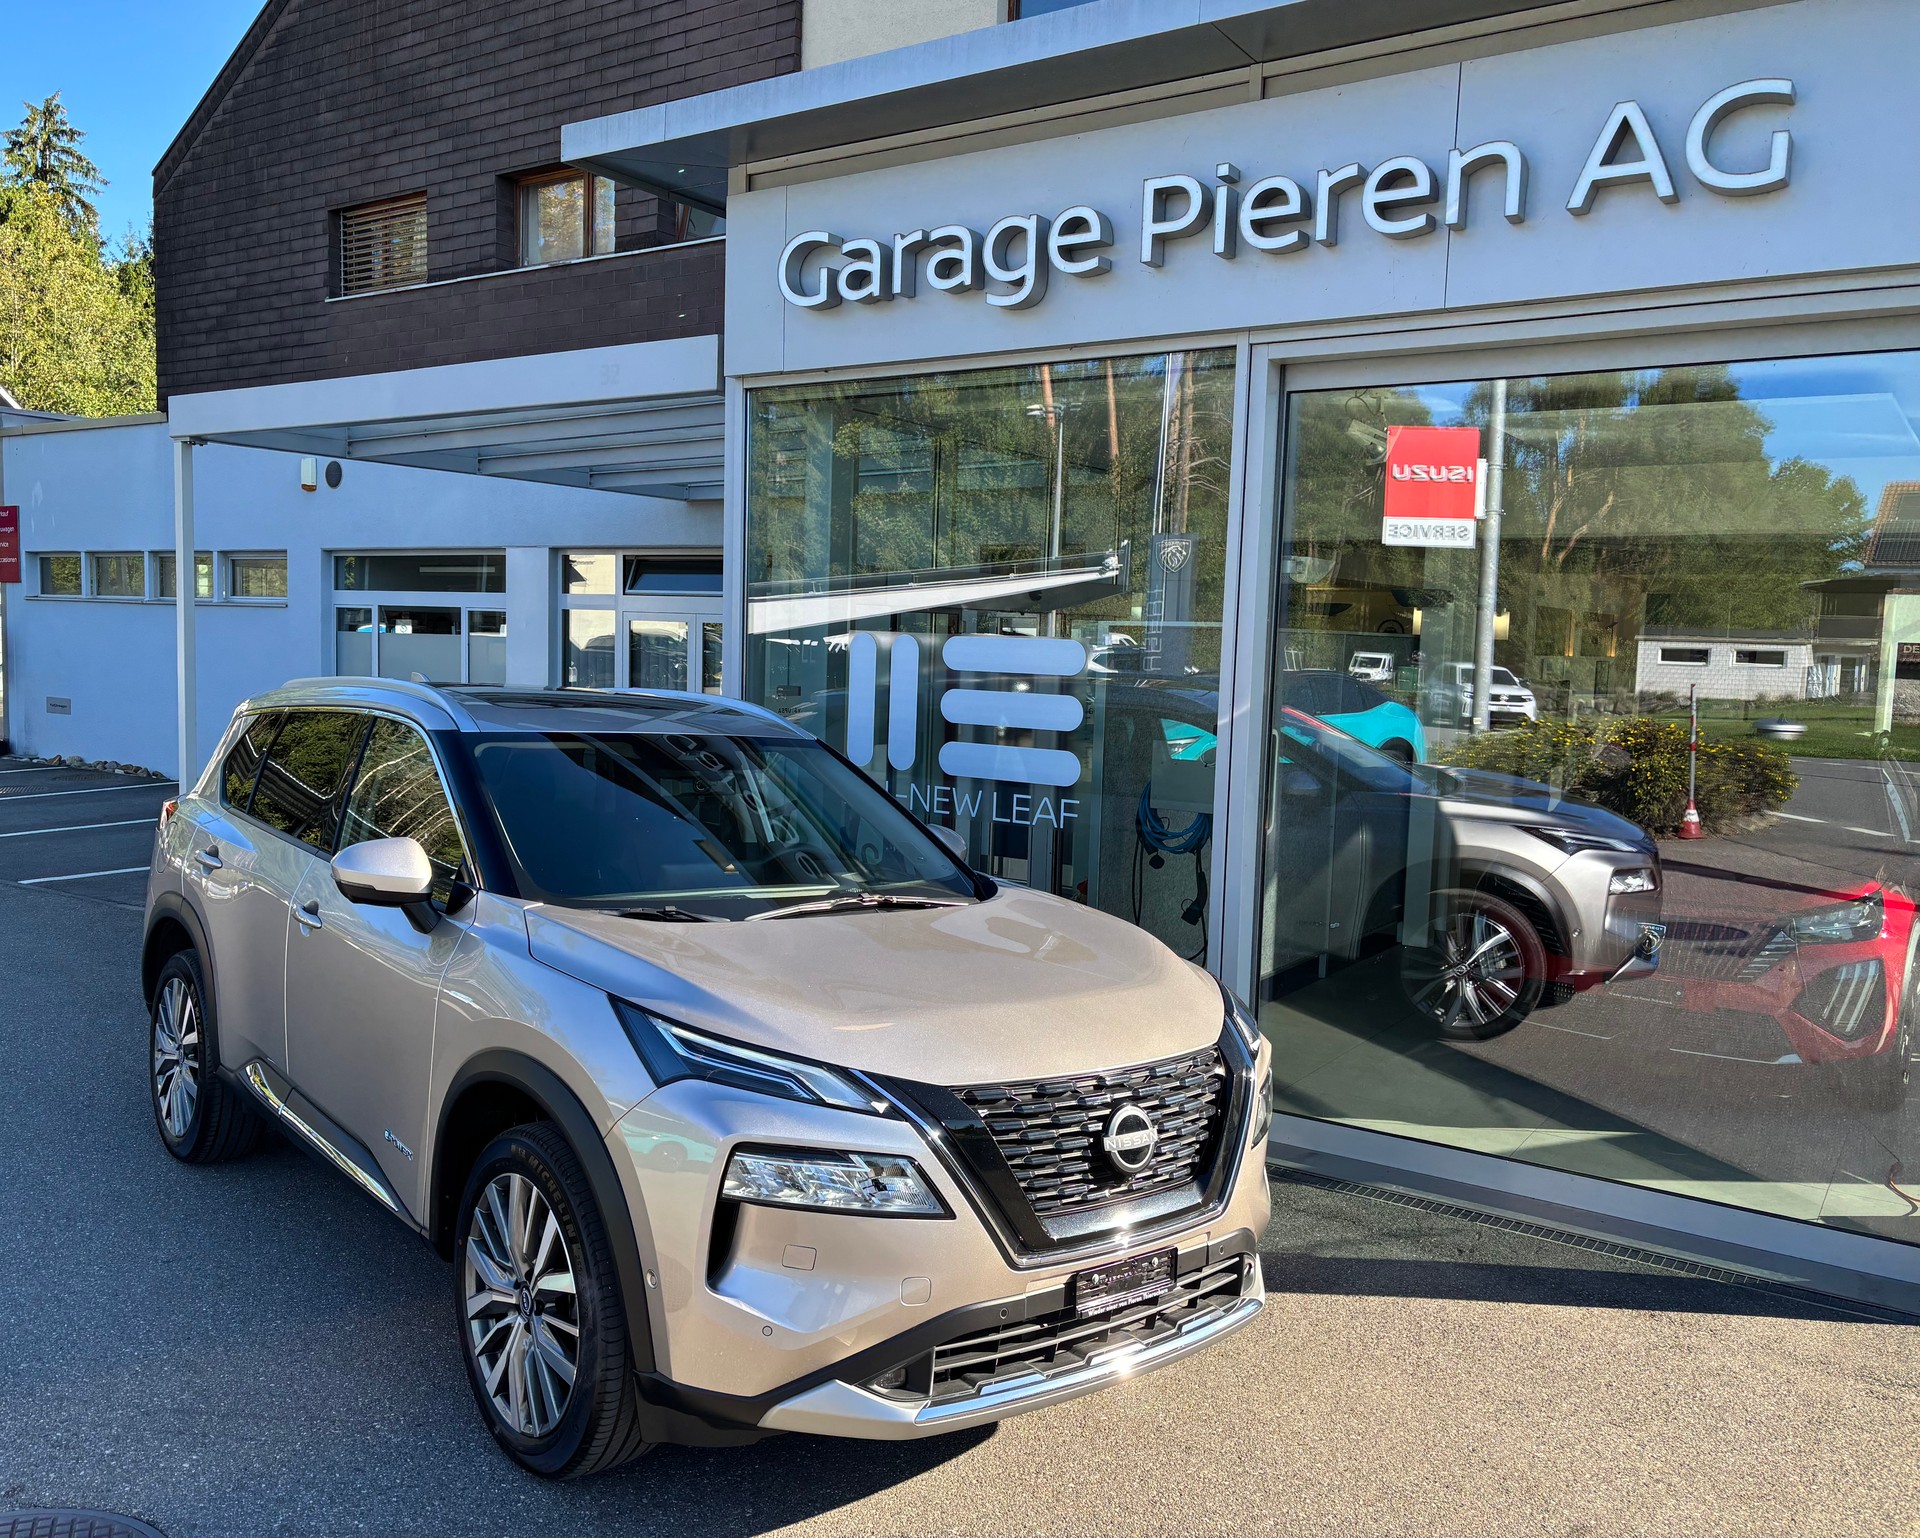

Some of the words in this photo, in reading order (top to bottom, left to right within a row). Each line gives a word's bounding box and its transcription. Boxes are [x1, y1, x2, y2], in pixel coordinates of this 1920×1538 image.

[777, 204, 1113, 310] Garage
[1140, 139, 1528, 267] Pieren
[1565, 78, 1797, 216] AG
[992, 790, 1080, 829] LEAF
[1106, 1131, 1158, 1149] NISSAN
[528, 1155, 576, 1238] MICHELIN
